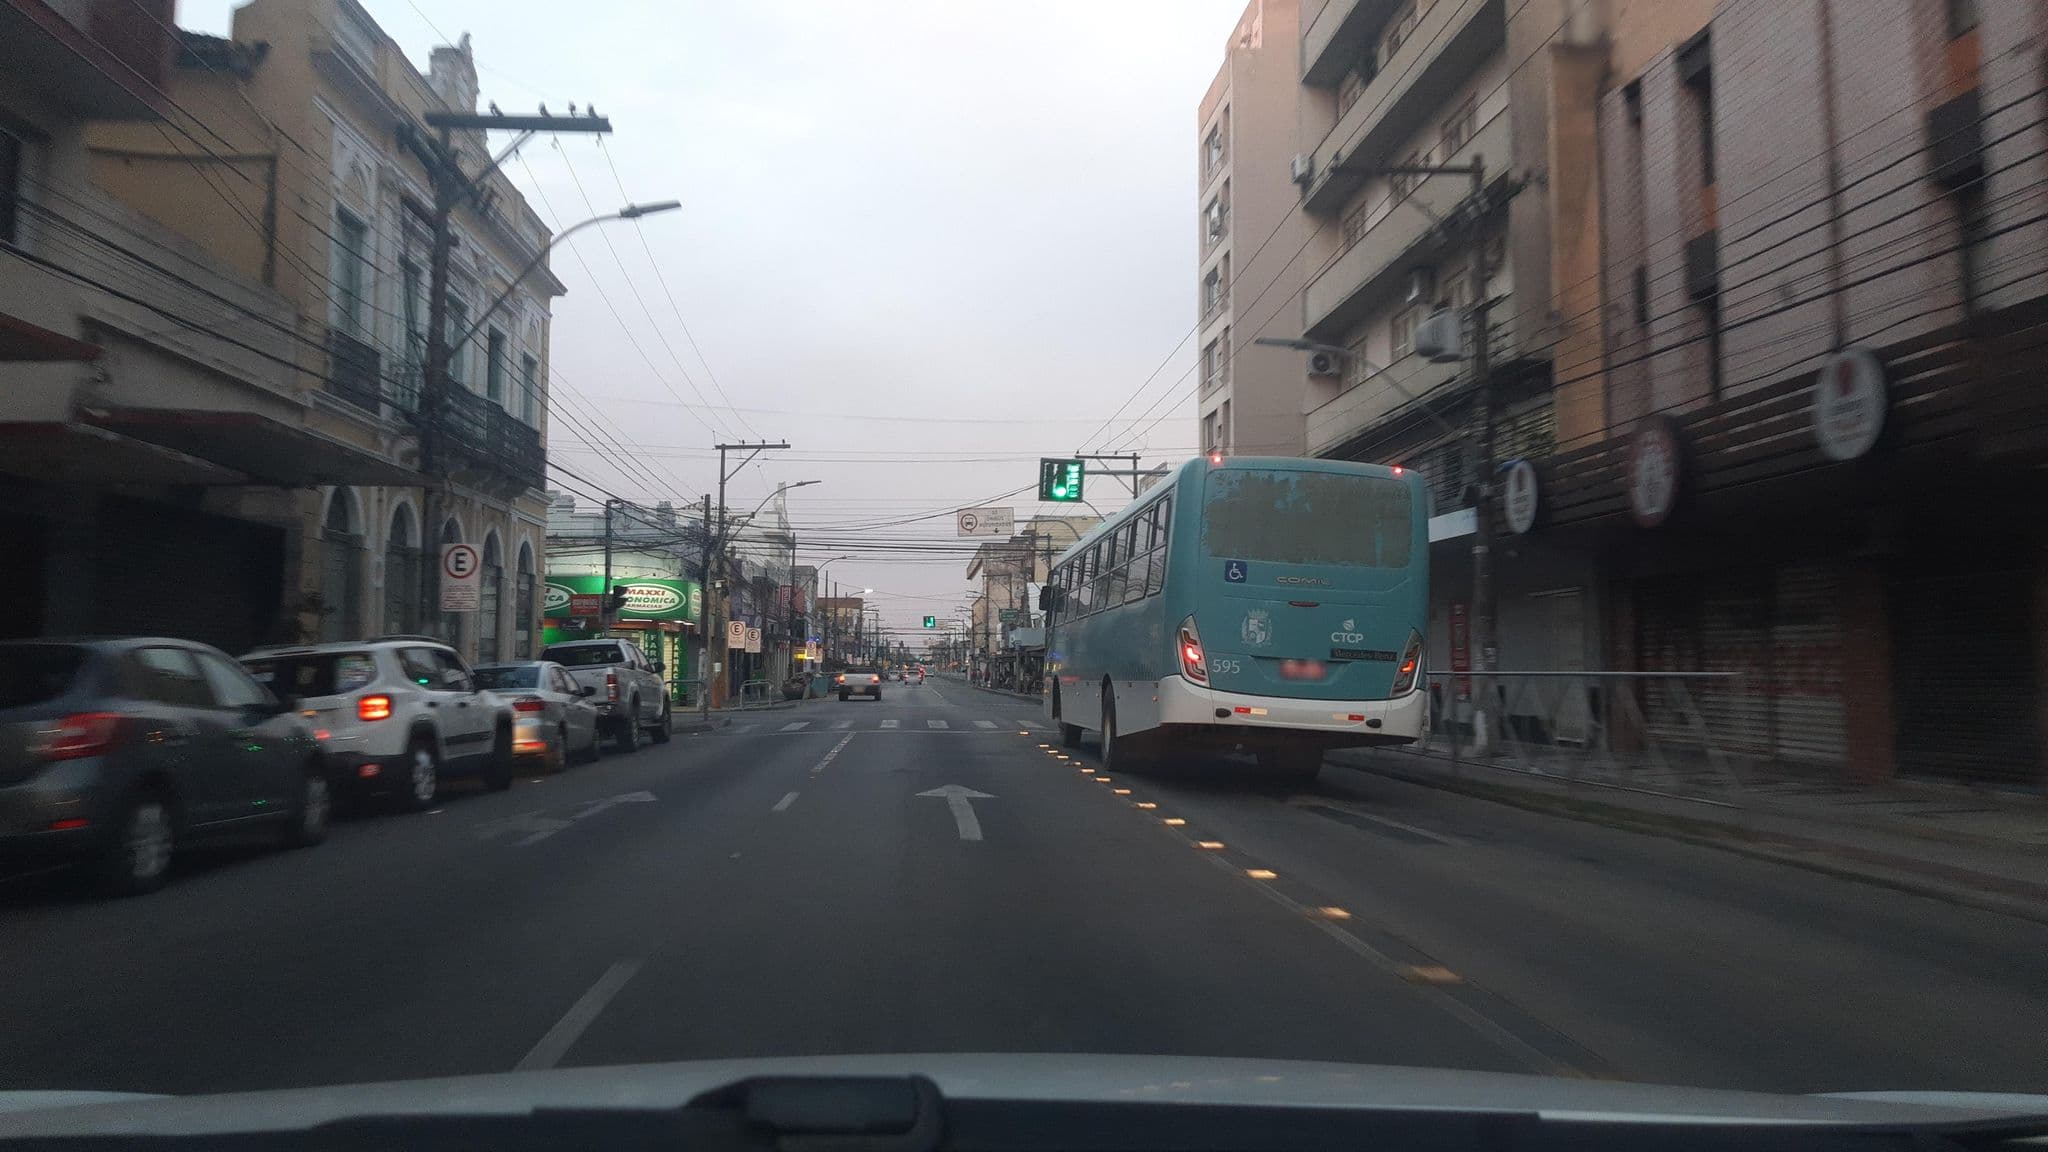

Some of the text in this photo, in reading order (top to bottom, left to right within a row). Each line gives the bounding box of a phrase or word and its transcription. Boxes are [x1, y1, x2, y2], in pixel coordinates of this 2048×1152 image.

[455, 552, 467, 571] E
[734, 624, 740, 633] E
[1331, 631, 1364, 644] CTCP
[1212, 659, 1241, 674] 595
